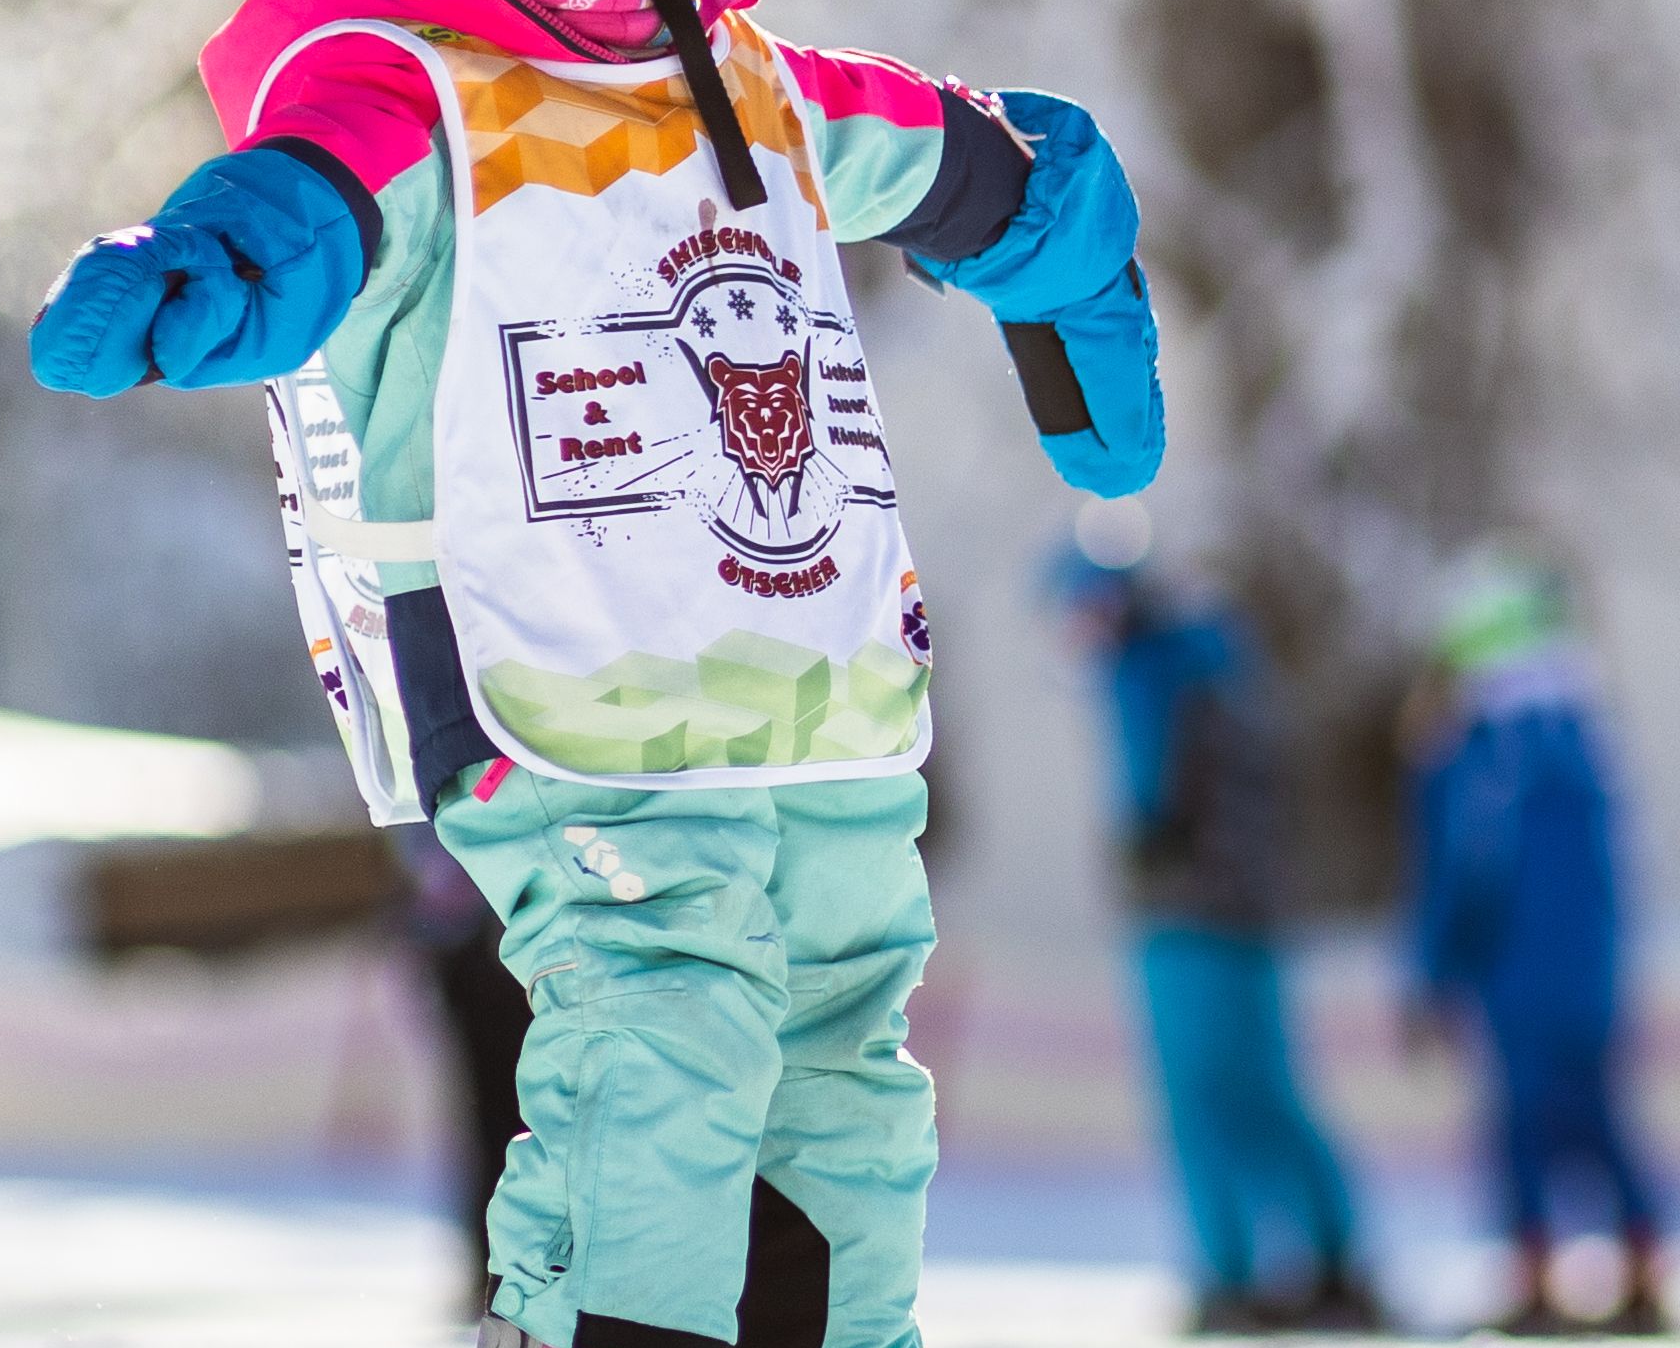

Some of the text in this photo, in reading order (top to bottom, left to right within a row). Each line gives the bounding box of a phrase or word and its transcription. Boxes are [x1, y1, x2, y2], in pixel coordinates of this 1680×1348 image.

[535, 360, 647, 395] School
[583, 401, 612, 425] &
[559, 430, 643, 462] Rent
[717, 552, 841, 599] ÖTSCHER
